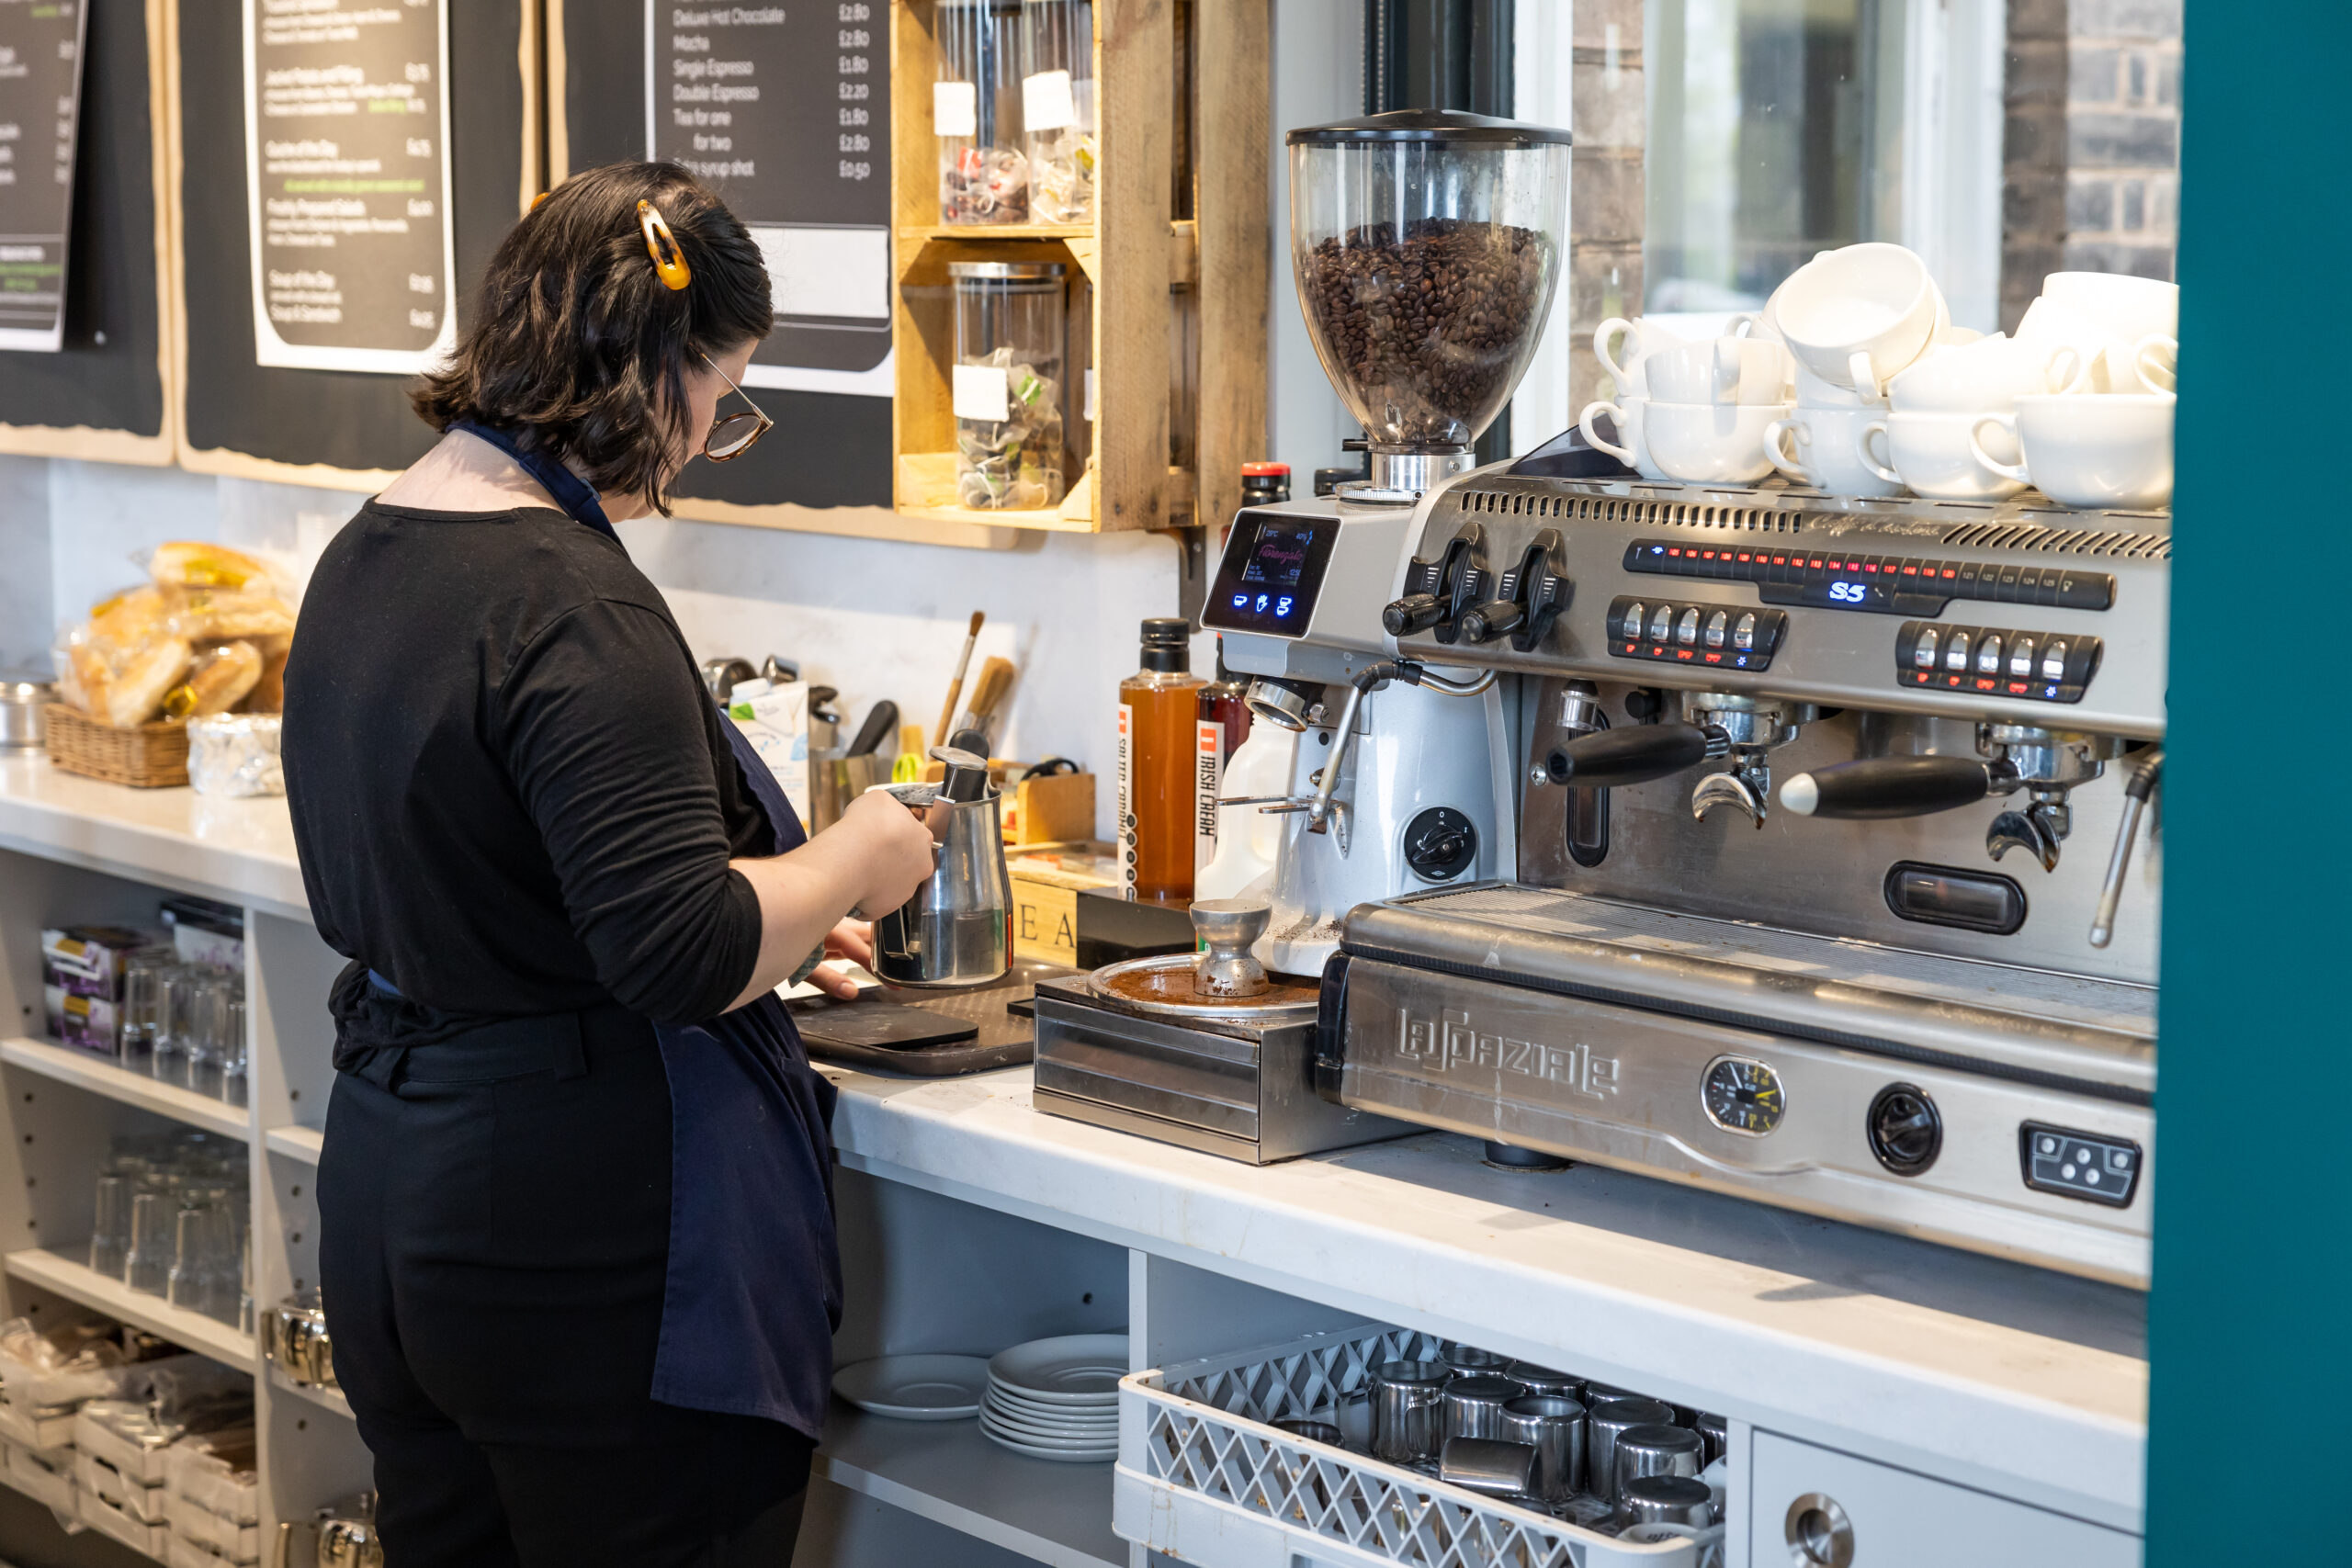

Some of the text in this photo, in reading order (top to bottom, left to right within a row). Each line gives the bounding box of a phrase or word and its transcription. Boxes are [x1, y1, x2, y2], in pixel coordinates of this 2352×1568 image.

[731, 6, 786, 25] Chocolate
[673, 34, 710, 51] Mocha
[673, 58, 706, 81] Single
[707, 57, 754, 79] Espresso
[673, 83, 710, 101] Double
[711, 83, 761, 104] Espresso
[673, 107, 694, 126] Tea
[694, 107, 708, 126] for
[709, 111, 731, 127] one
[693, 132, 708, 152] for
[710, 134, 732, 152] two
[1829, 581, 1866, 603] S5
[1199, 756, 1216, 837] IRISH CREAM
